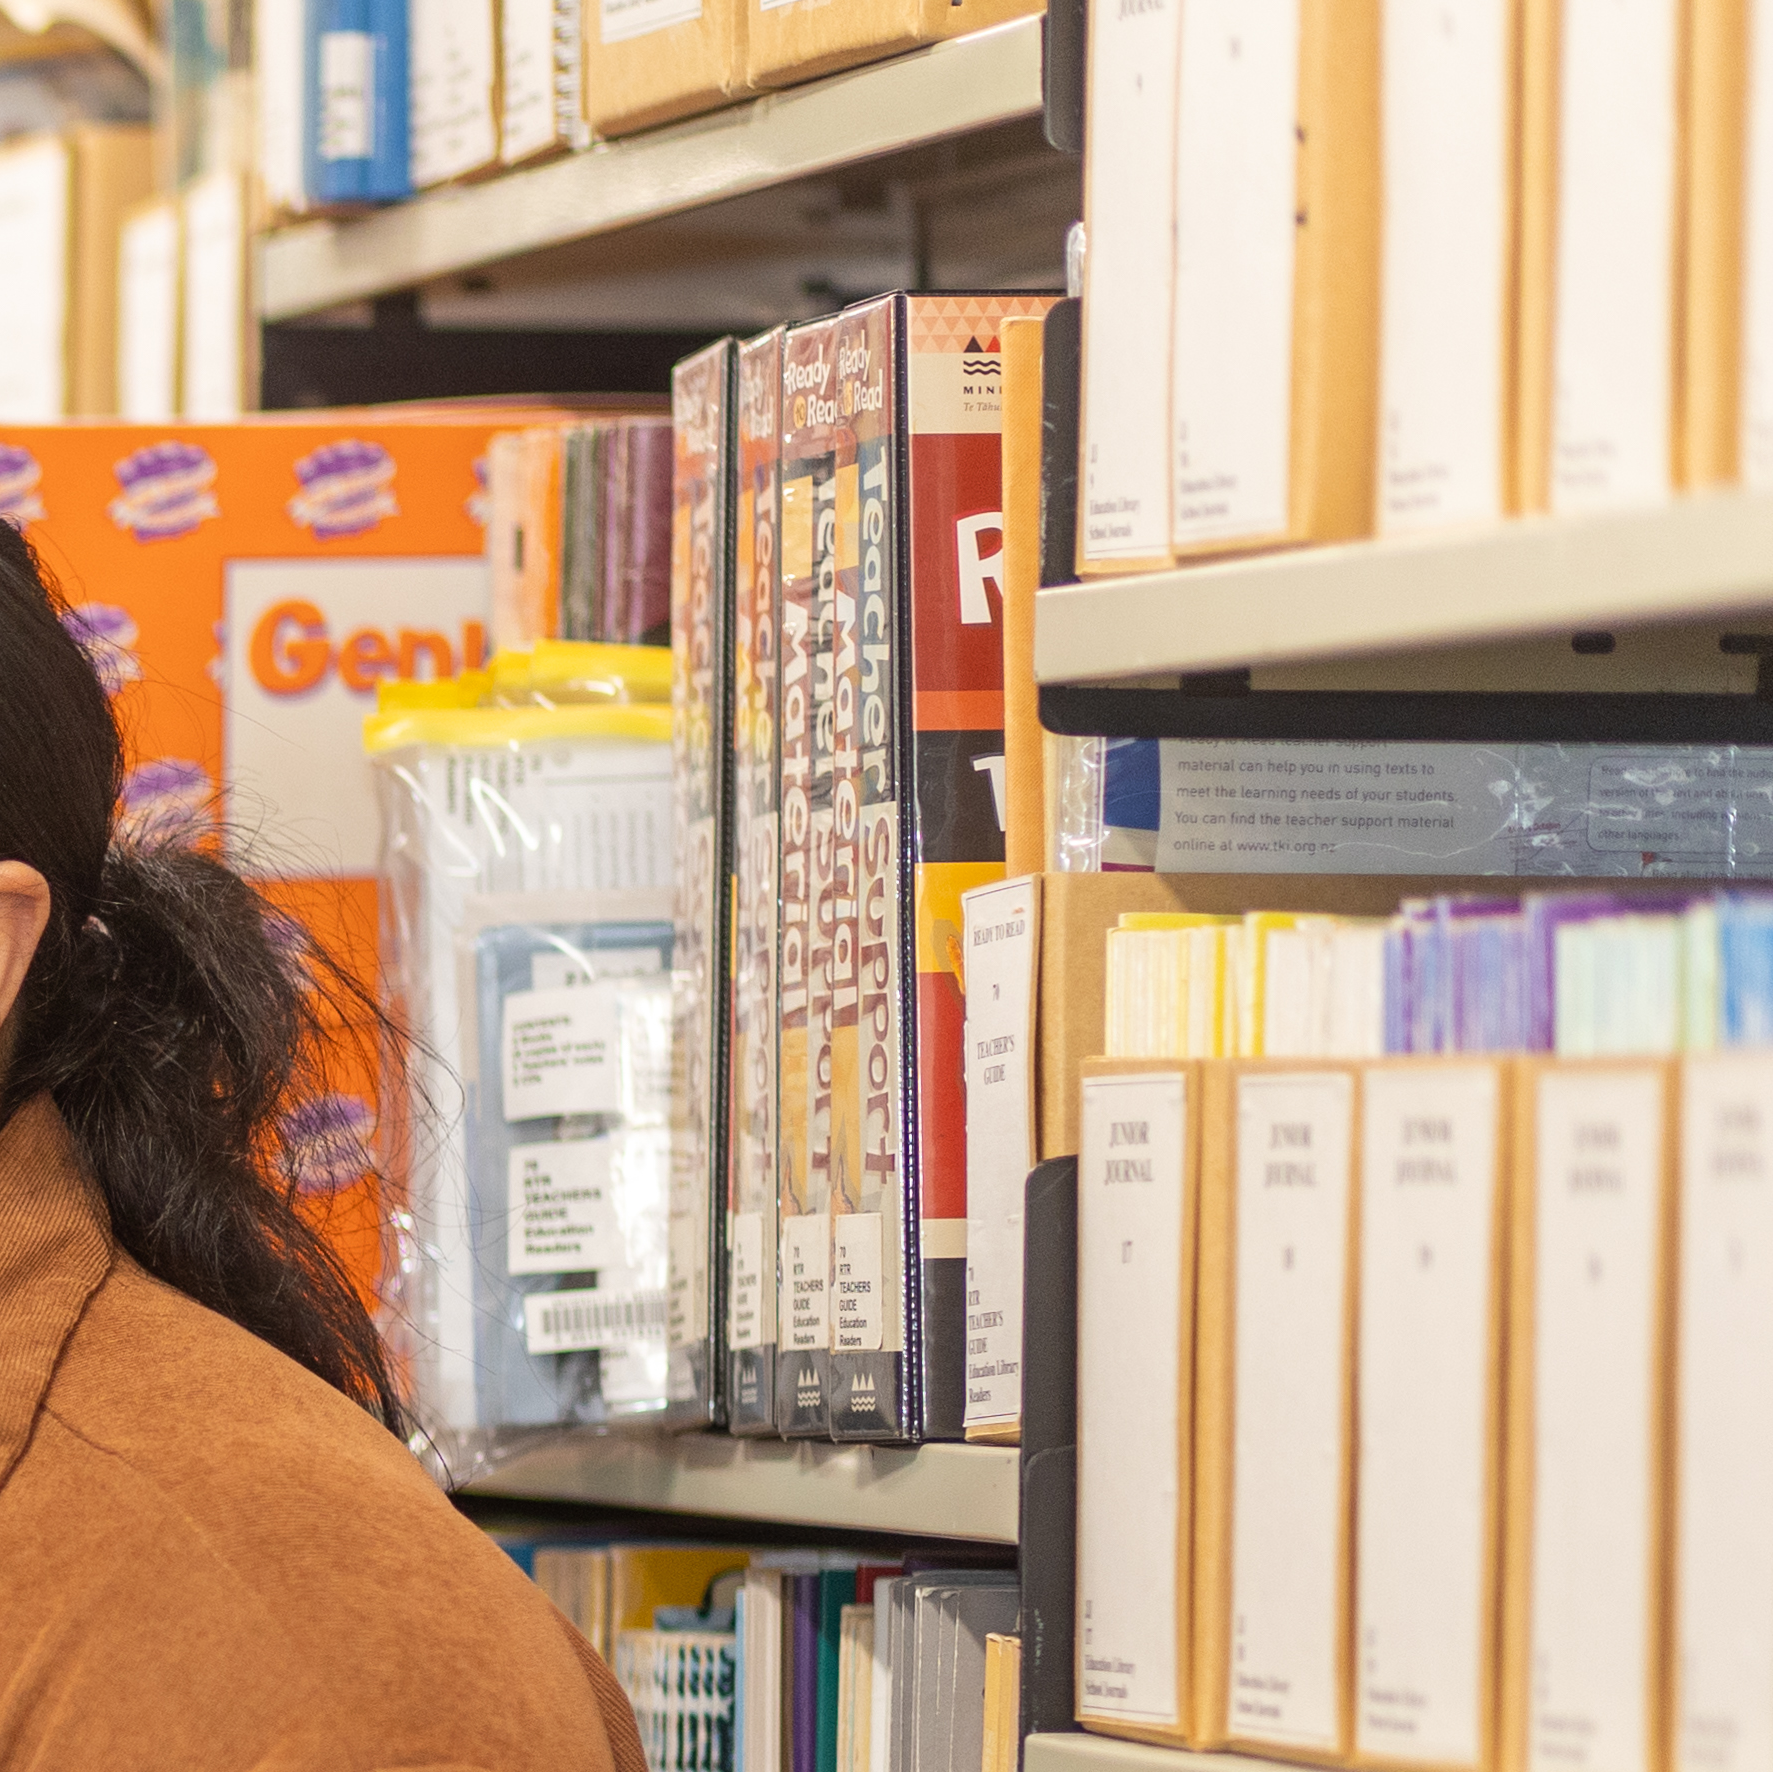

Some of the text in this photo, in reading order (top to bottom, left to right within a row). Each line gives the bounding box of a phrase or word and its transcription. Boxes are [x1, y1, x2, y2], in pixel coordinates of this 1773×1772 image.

[840, 329, 871, 381] Ready
[785, 343, 830, 395] Ready
[854, 369, 883, 413] Read
[807, 394, 837, 427] Rea
[1178, 759, 1435, 778] material can help you in using texts to
[834, 590, 858, 1011] Material
[1176, 785, 1392, 804] meet the learning needs of your
[783, 600, 809, 1012] Material
[861, 445, 896, 1185] Teacher Support
[752, 471, 777, 1184] Teacher Support
[1174, 811, 1455, 830] You can find the teacher support material
[1174, 839, 1215, 851] online
[1220, 840, 1232, 851] at
[973, 919, 1025, 947] READY TO READ
[810, 828, 834, 1182] Support
[977, 1034, 1015, 1061] TEACHER'S
[983, 1064, 1006, 1086] GUIDE
[1109, 1121, 1150, 1148] JUNIOR
[1104, 1158, 1153, 1186] JOURNAL
[525, 1188, 602, 1205] TEACHERS
[524, 1224, 594, 1240] Education
[524, 1240, 582, 1255] Readers
[839, 1246, 847, 1258] 70
[839, 1263, 852, 1275] RTR
[793, 1279, 824, 1293] TEACHERS
[839, 1280, 871, 1294] TEACHERS
[793, 1298, 811, 1310] GUIDE
[839, 1299, 857, 1311] GUIDE
[793, 1316, 820, 1328] Education
[839, 1316, 867, 1329] Education
[968, 1310, 1004, 1331] TEACHER'S
[793, 1333, 815, 1345] Readers
[839, 1334, 862, 1346] Readers
[968, 1337, 988, 1355] GUIDE
[968, 1359, 1019, 1380] Education Library
[968, 1387, 992, 1404] Readers
